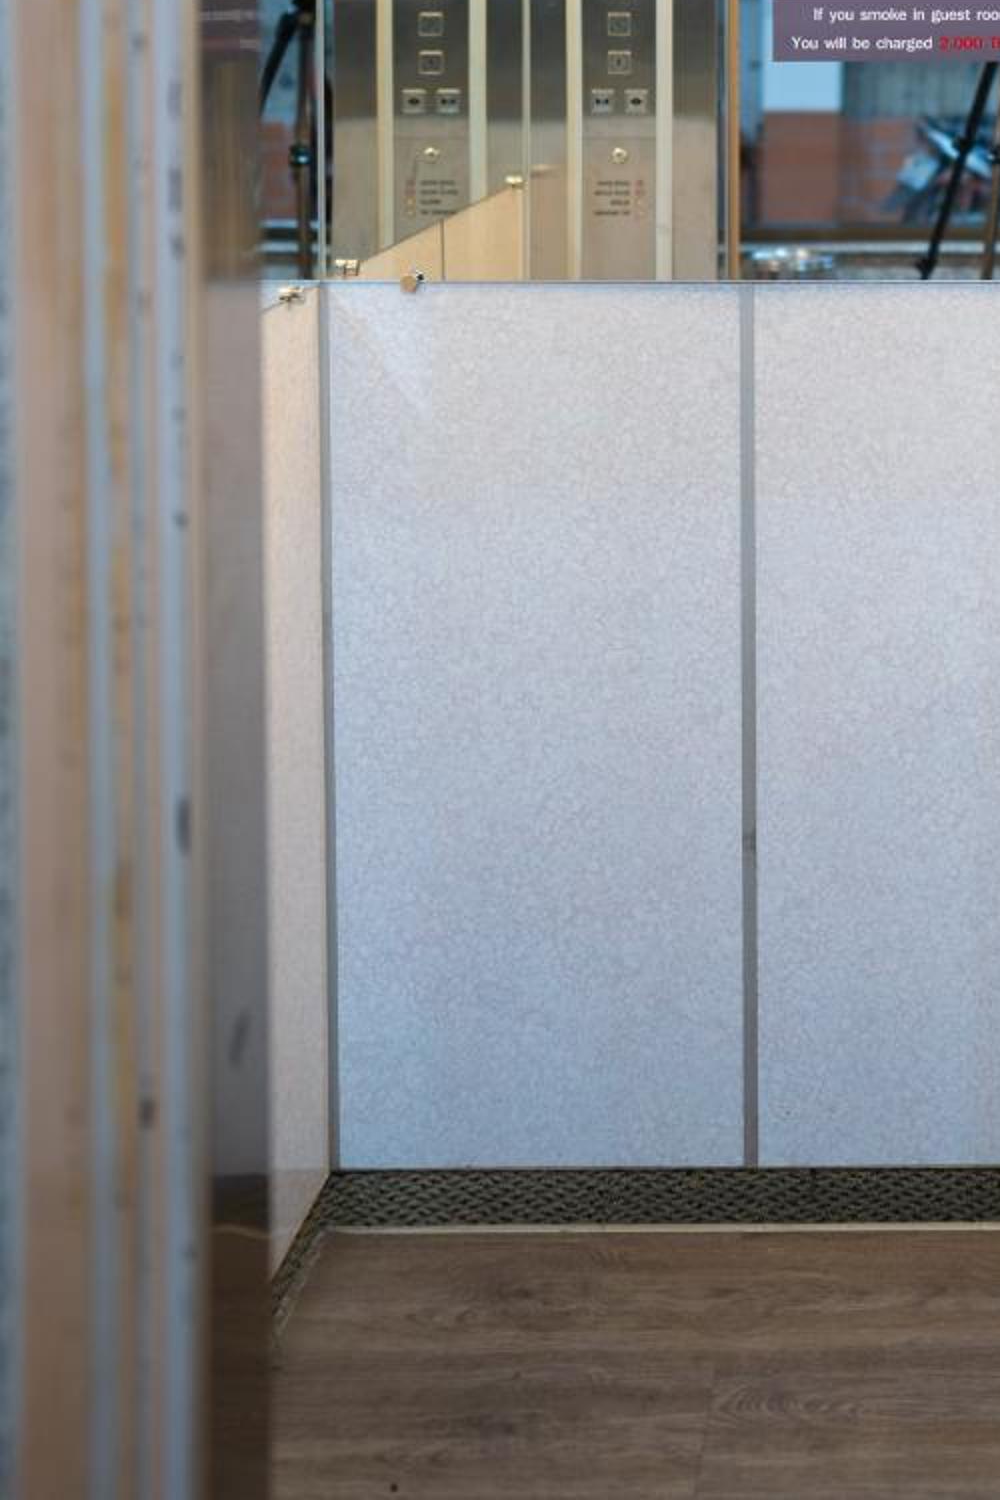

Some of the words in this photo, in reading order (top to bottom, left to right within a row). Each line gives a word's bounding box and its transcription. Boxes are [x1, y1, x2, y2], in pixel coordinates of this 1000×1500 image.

[813, 7, 824, 21] If
[829, 10, 855, 24] you
[860, 7, 907, 21] smoke
[913, 7, 926, 21] in
[931, 8, 971, 24] guest
[791, 35, 820, 51] You
[824, 36, 847, 50] will
[852, 36, 870, 50] be
[876, 35, 933, 53] charged
